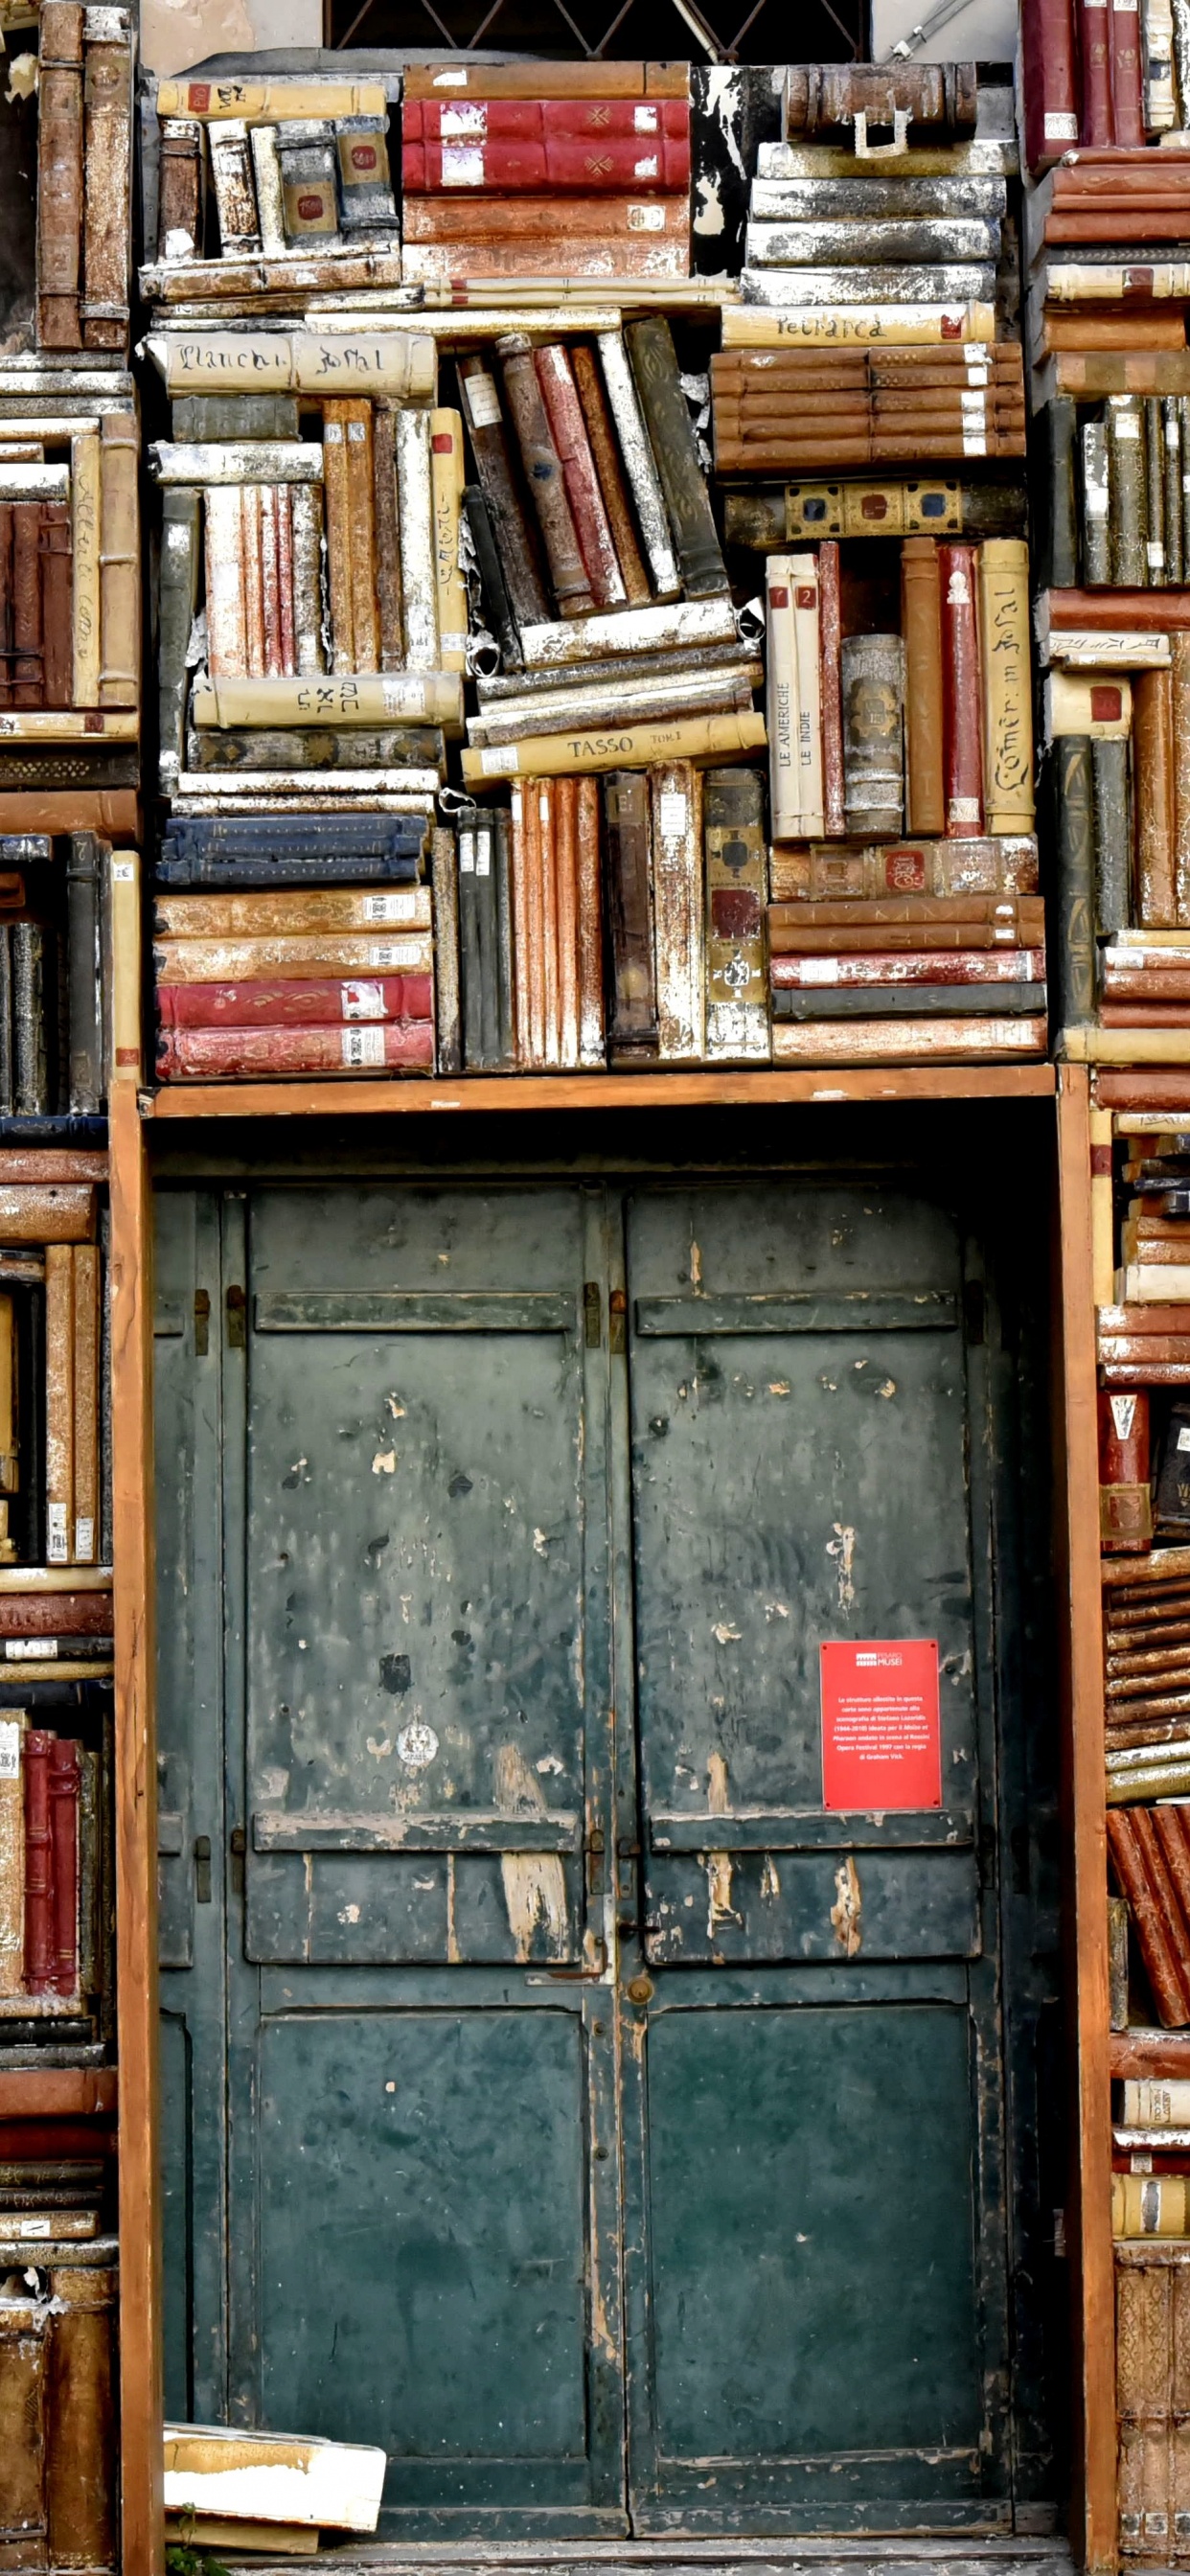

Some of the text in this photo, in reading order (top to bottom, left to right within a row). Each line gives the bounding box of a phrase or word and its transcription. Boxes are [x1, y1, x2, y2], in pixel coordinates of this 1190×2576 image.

[567, 736, 634, 757] TASSO
[776, 682, 790, 768] LE AMERICHE
[799, 711, 812, 766] LE INDIE
